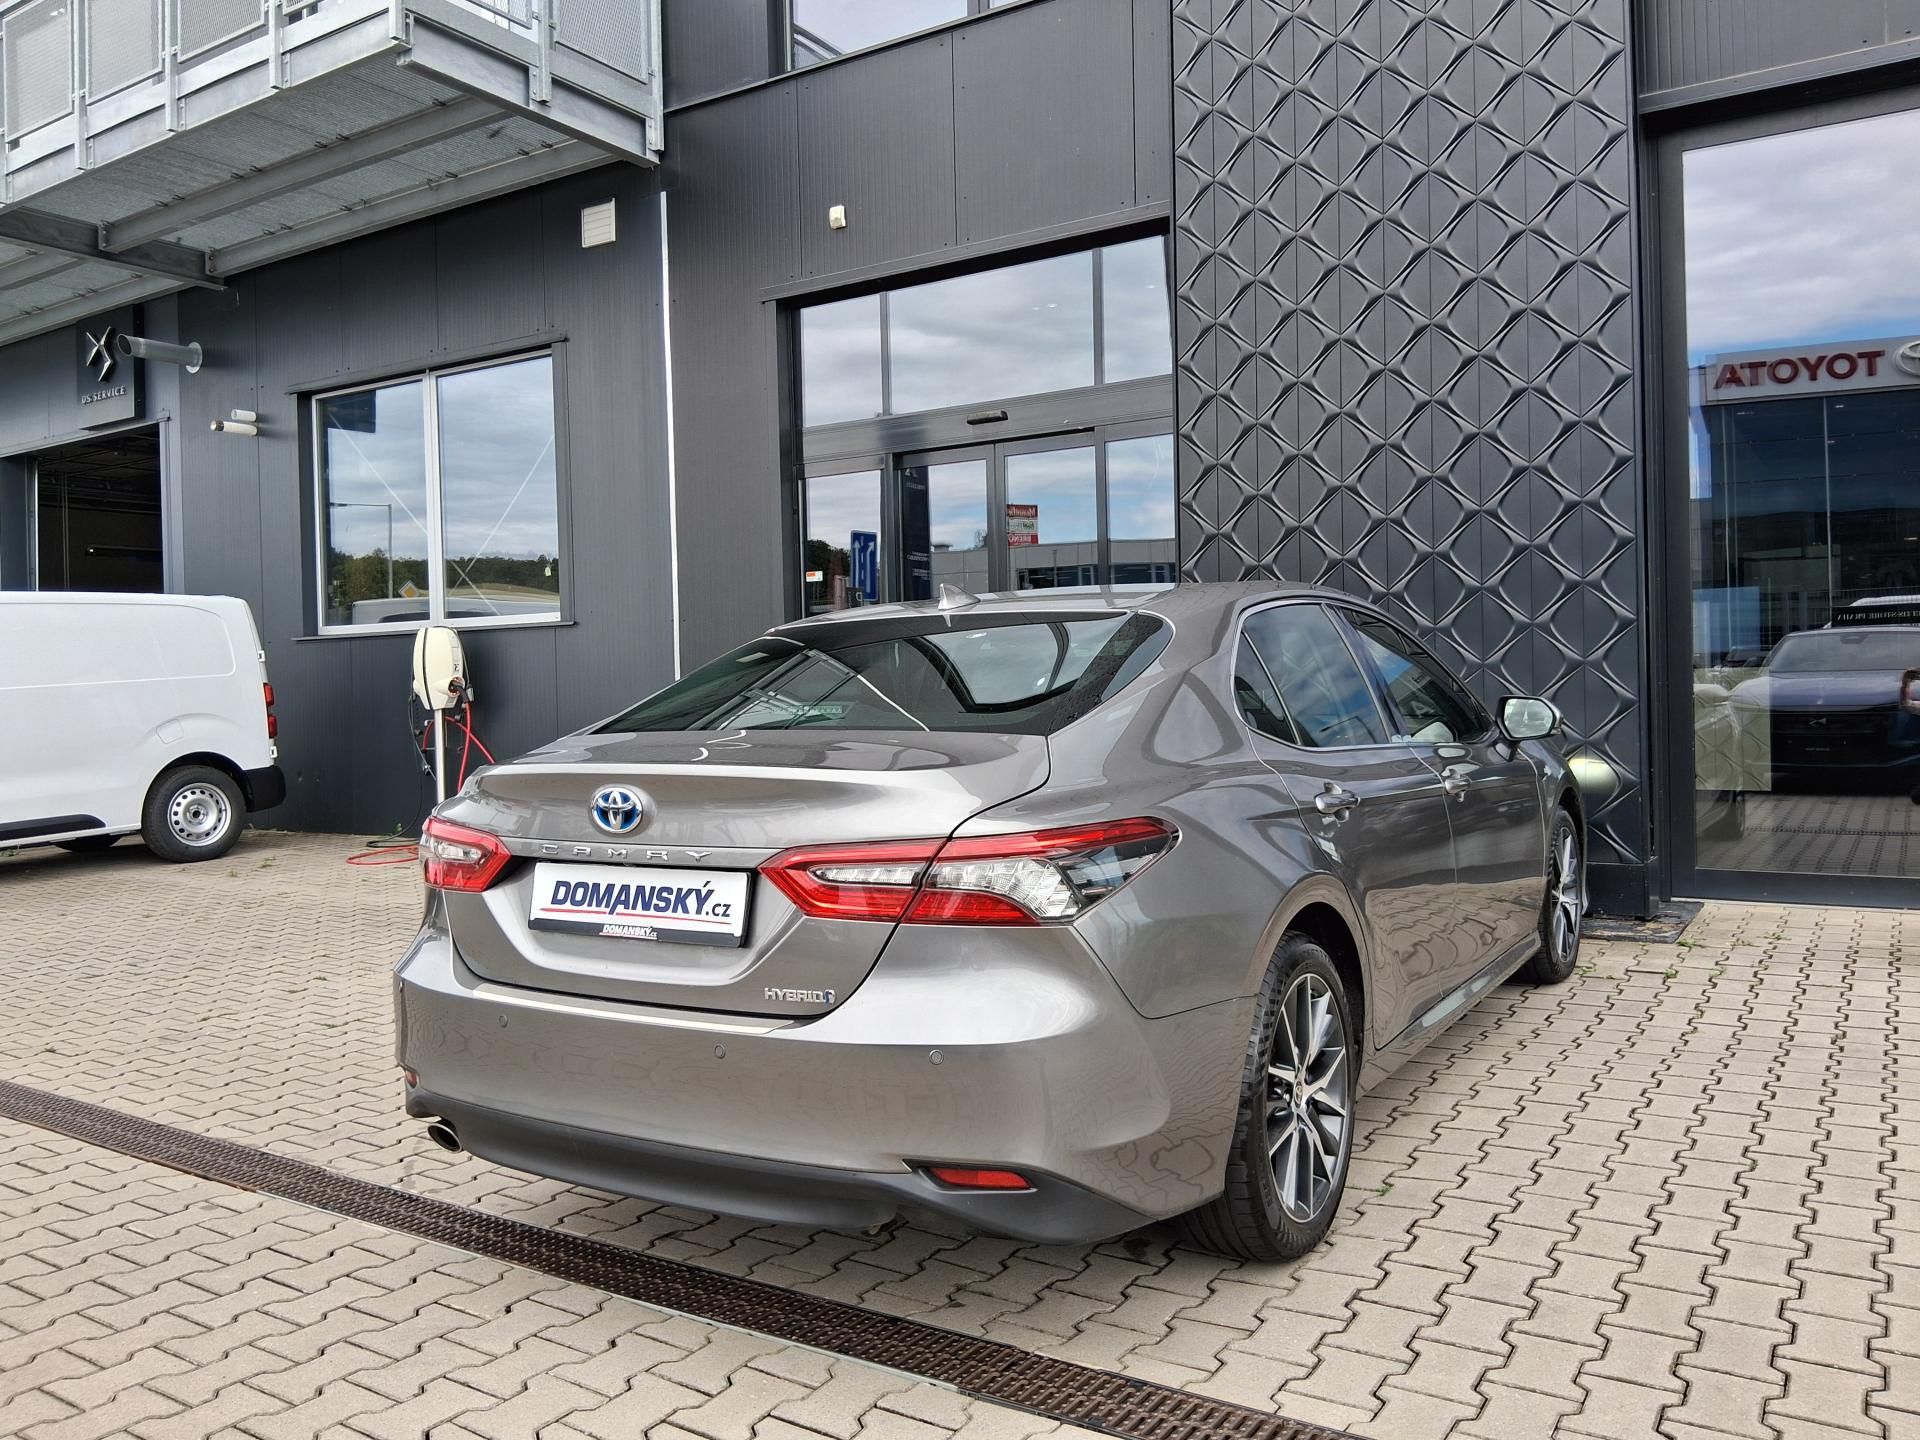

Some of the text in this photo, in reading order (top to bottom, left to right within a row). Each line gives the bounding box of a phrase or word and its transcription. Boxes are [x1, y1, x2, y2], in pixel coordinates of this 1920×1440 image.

[93, 385, 126, 402] SERVICE
[541, 844, 712, 863] CAMRY
[764, 987, 826, 1003] HYBRID
